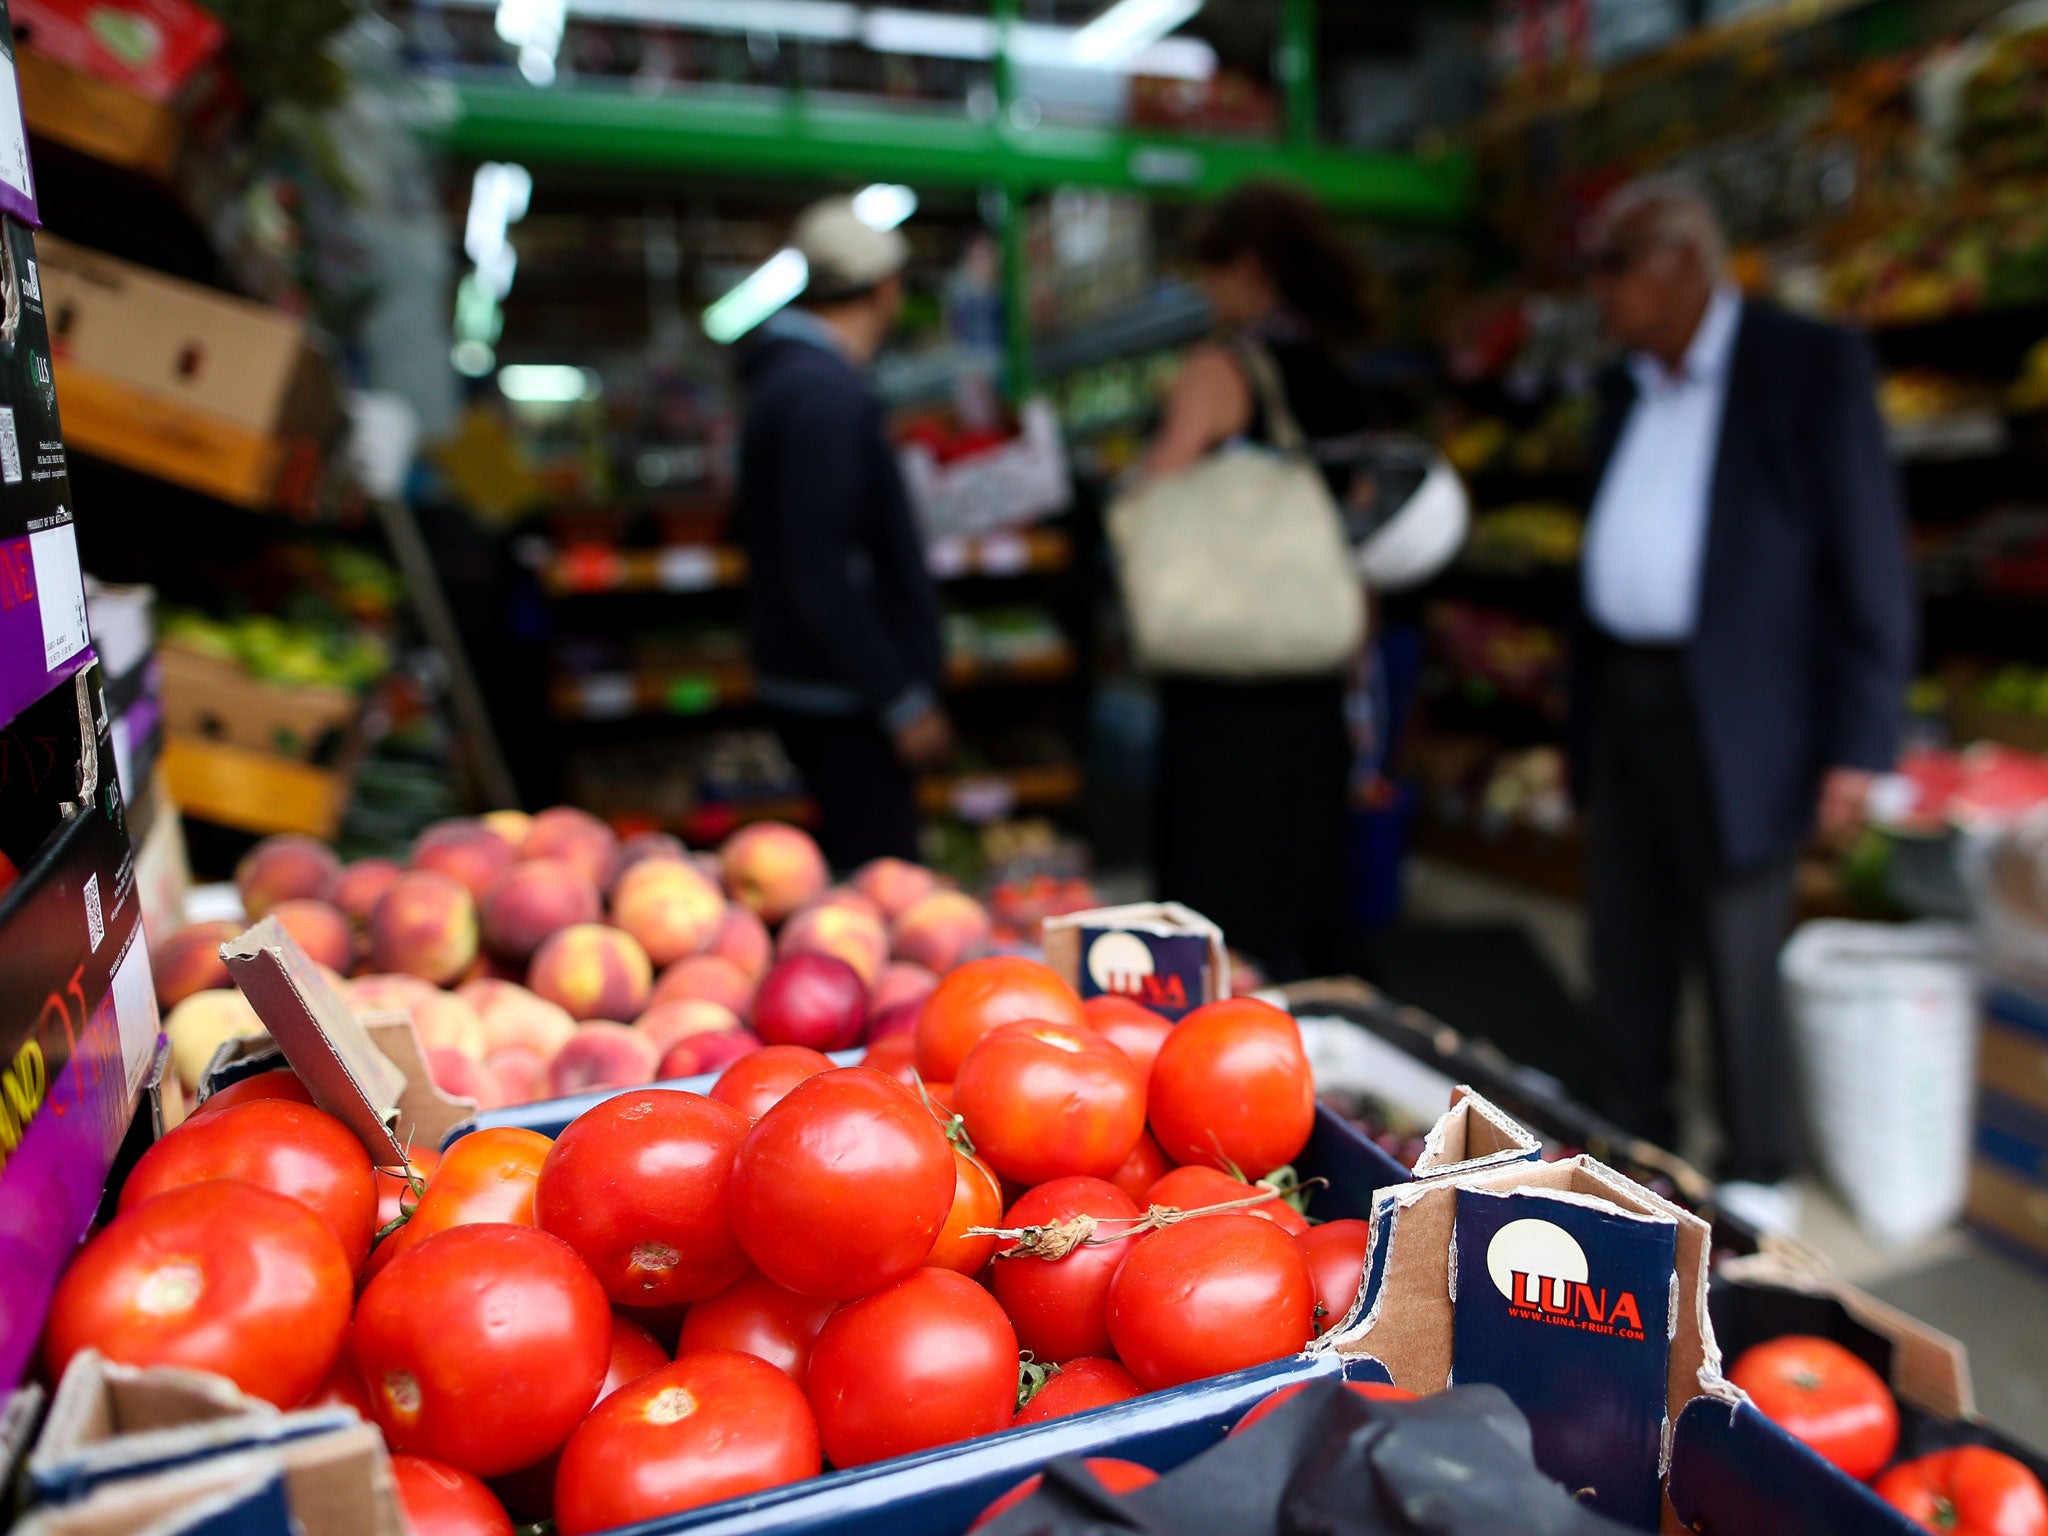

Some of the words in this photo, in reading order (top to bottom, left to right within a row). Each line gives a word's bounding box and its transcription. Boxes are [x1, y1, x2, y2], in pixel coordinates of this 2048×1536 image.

[1108, 971, 1188, 1009] LUNA
[1511, 1270, 1644, 1331] LUNA
[1508, 1307, 1645, 1341] WWW.LUNA-FRUIT.COM
